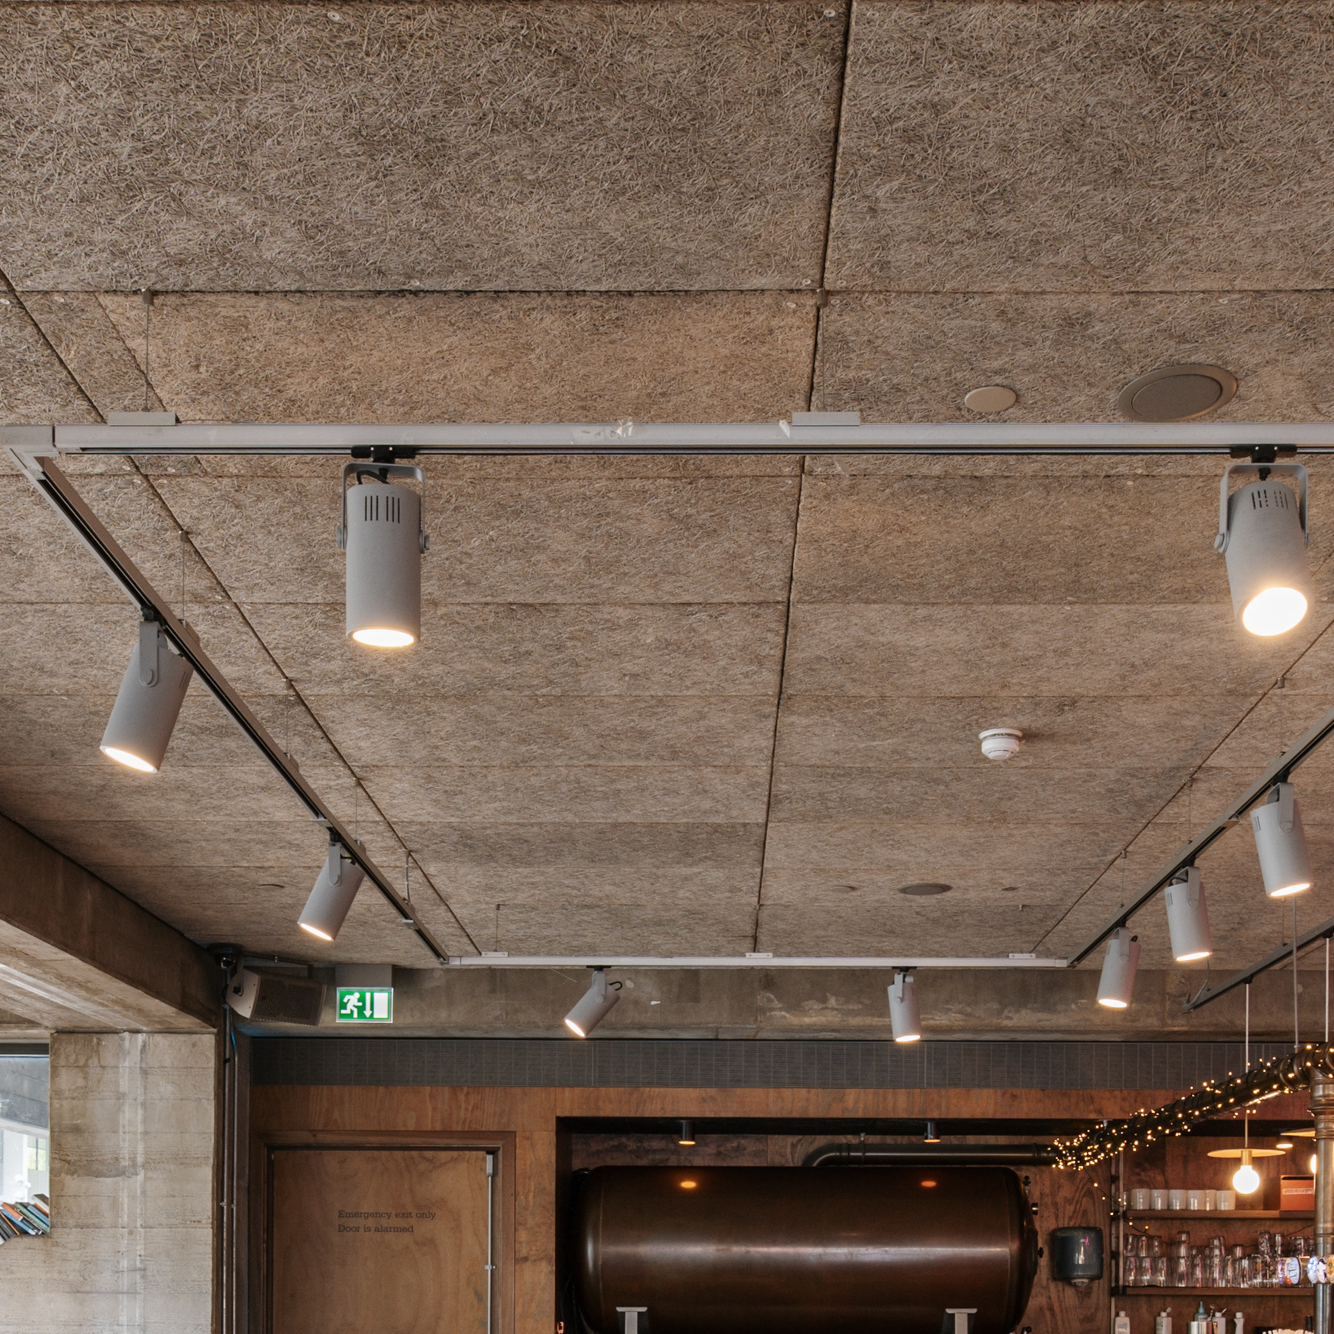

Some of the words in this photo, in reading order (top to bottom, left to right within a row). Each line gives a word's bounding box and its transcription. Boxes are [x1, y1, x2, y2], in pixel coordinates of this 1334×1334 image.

[338, 1210, 392, 1220] Emergency
[415, 1210, 436, 1220] only
[338, 1224, 360, 1233] Door
[363, 1224, 371, 1233] is
[374, 1224, 414, 1233] alarmed
